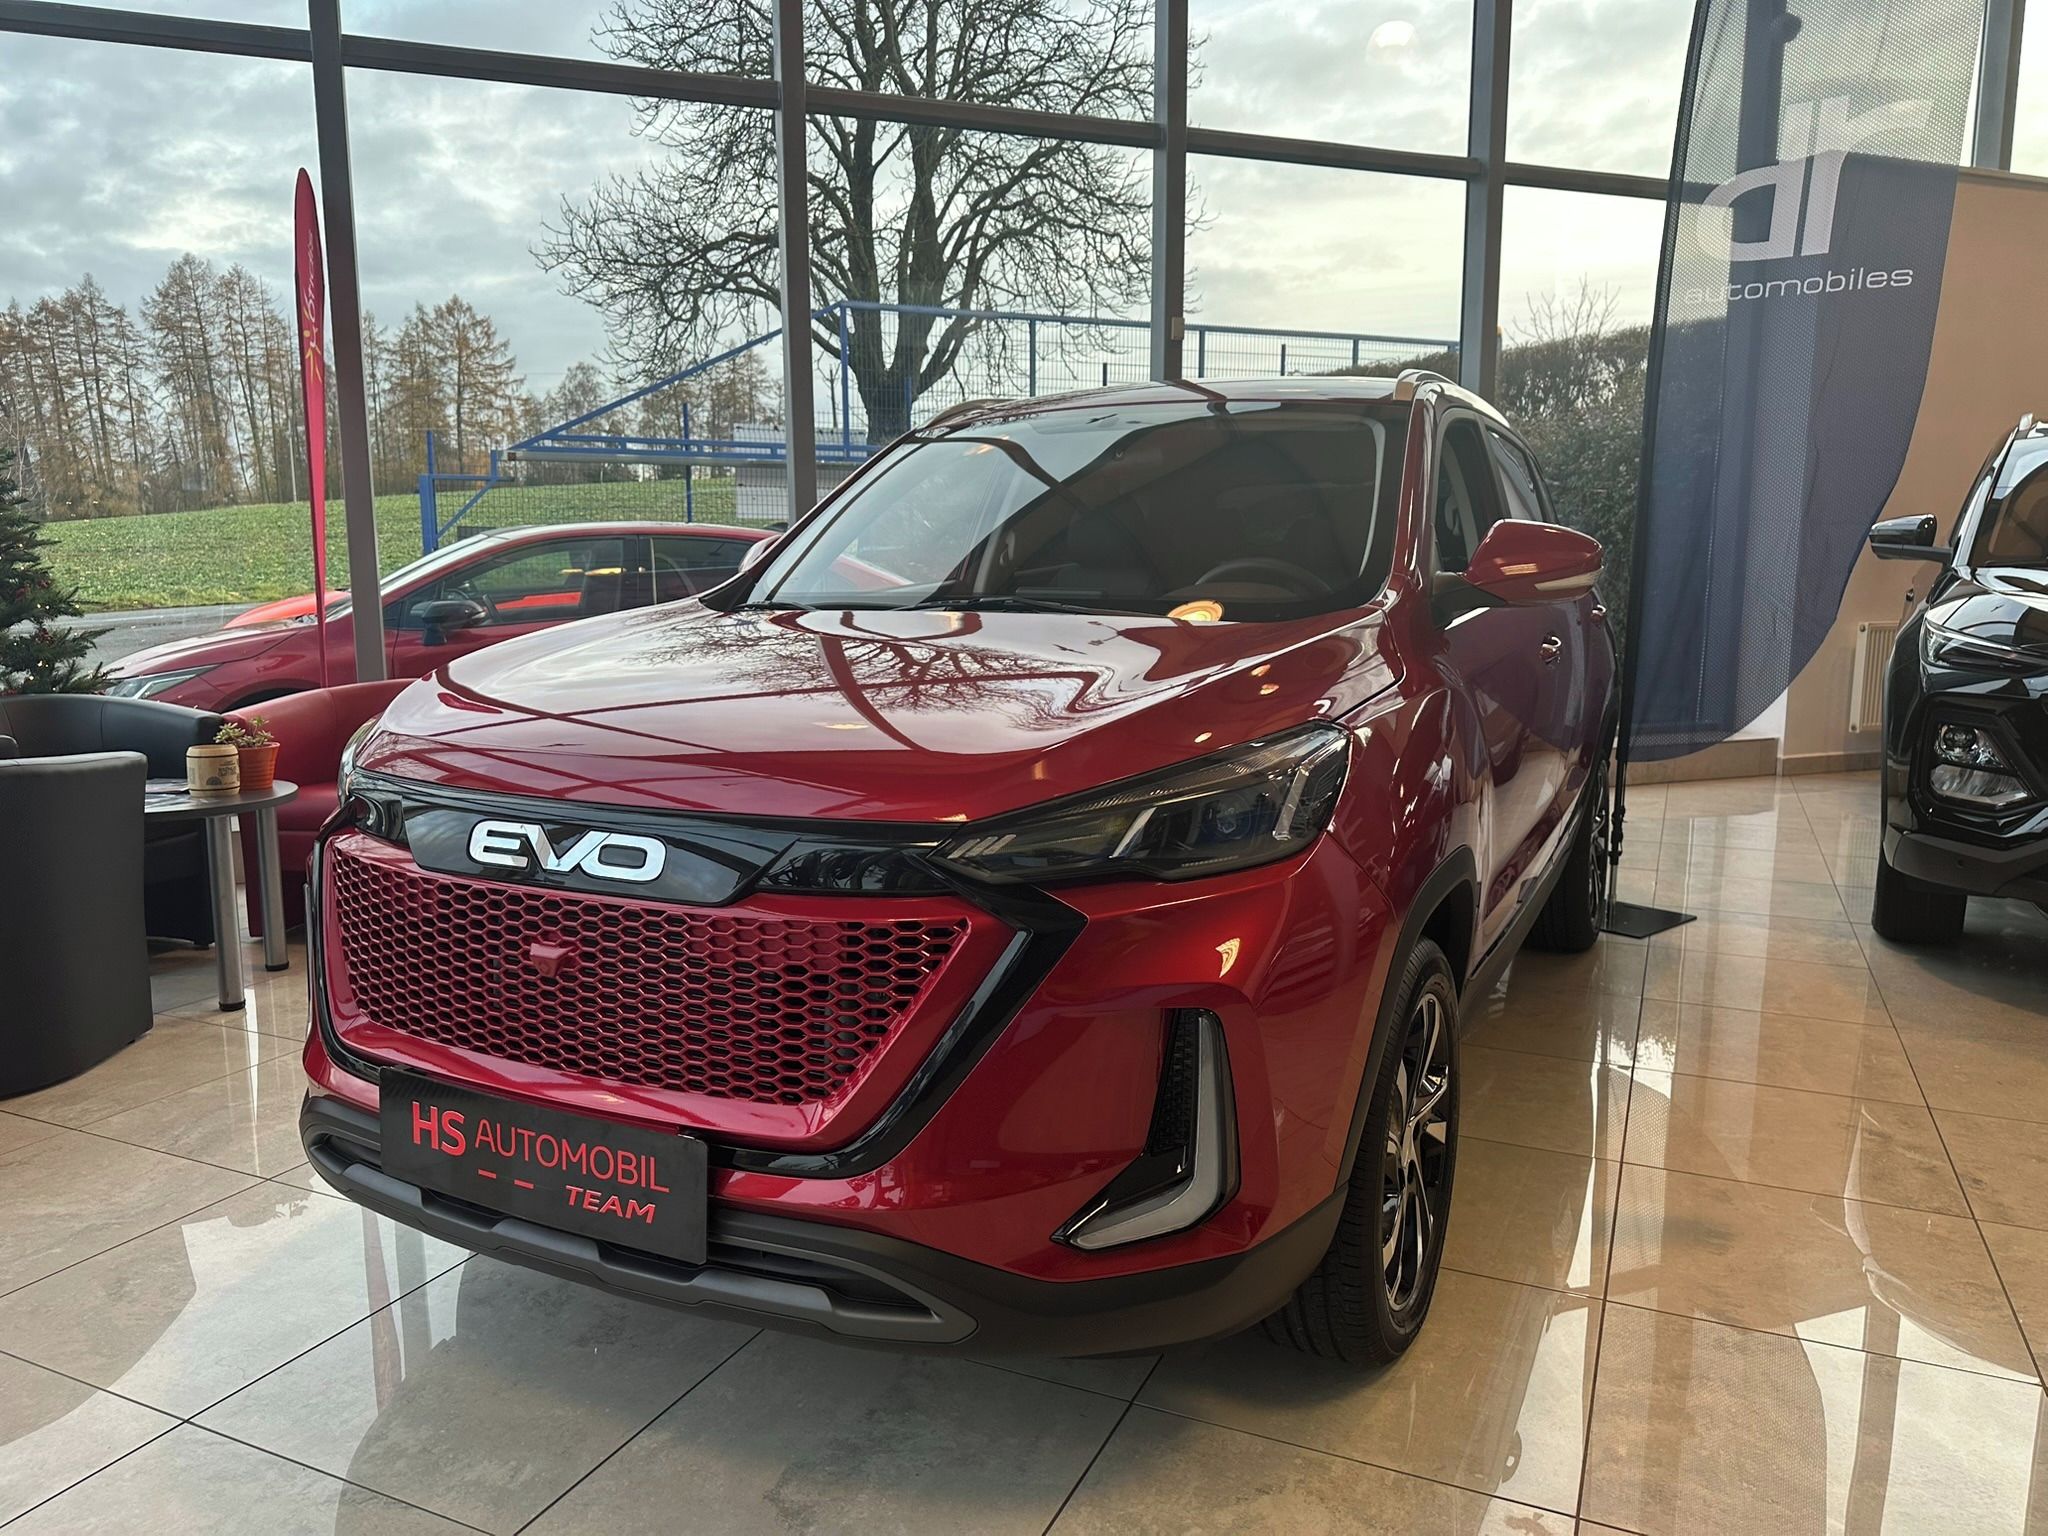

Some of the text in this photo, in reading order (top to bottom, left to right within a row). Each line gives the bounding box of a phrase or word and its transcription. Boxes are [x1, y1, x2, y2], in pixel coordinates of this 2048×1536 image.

[1686, 267, 1914, 303] automobiles
[468, 819, 667, 882] EVO
[411, 1100, 670, 1193] HS AUTOMOBIL
[565, 1184, 656, 1224] TEAM
